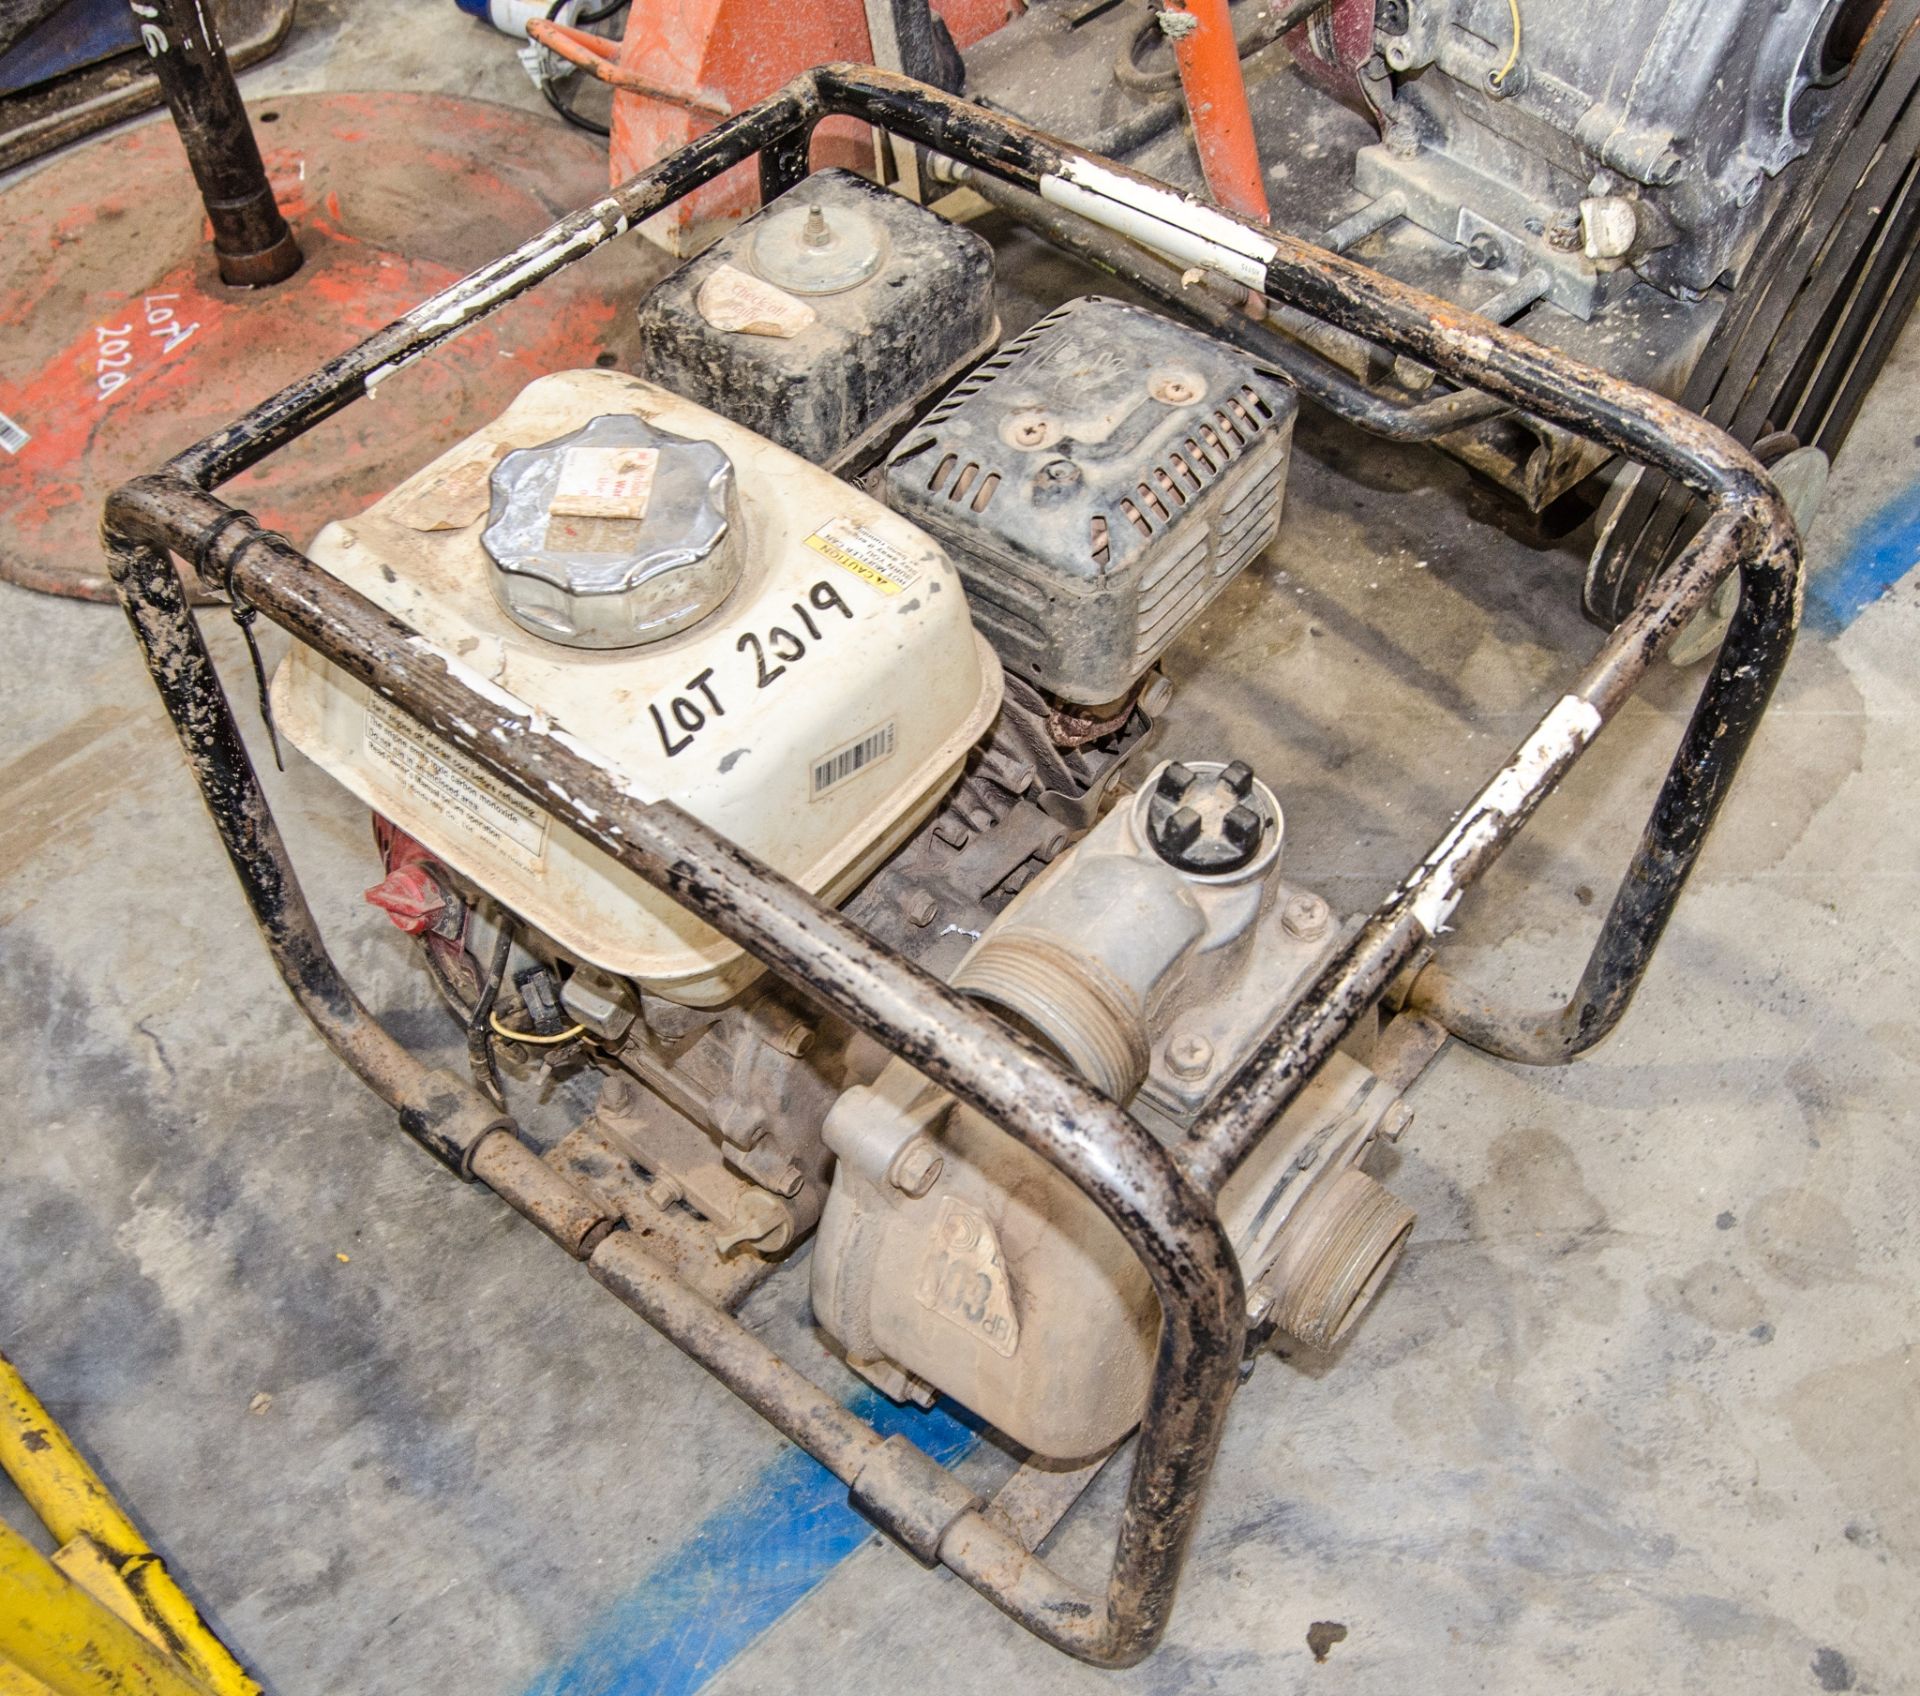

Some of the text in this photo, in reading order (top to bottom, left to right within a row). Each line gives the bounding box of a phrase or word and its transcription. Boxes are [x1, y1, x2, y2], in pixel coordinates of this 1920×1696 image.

[733, 284, 768, 309] Check
[145, 294, 189, 346] LOT
[97, 324, 133, 399] 2020
[818, 544, 875, 579] CAUTION
[824, 534, 905, 585] HOT MUFFLER CAN
[876, 547, 897, 561] away
[886, 563, 912, 580] BURN
[648, 581, 853, 757] LOT 2019
[450, 772, 476, 797] carbon
